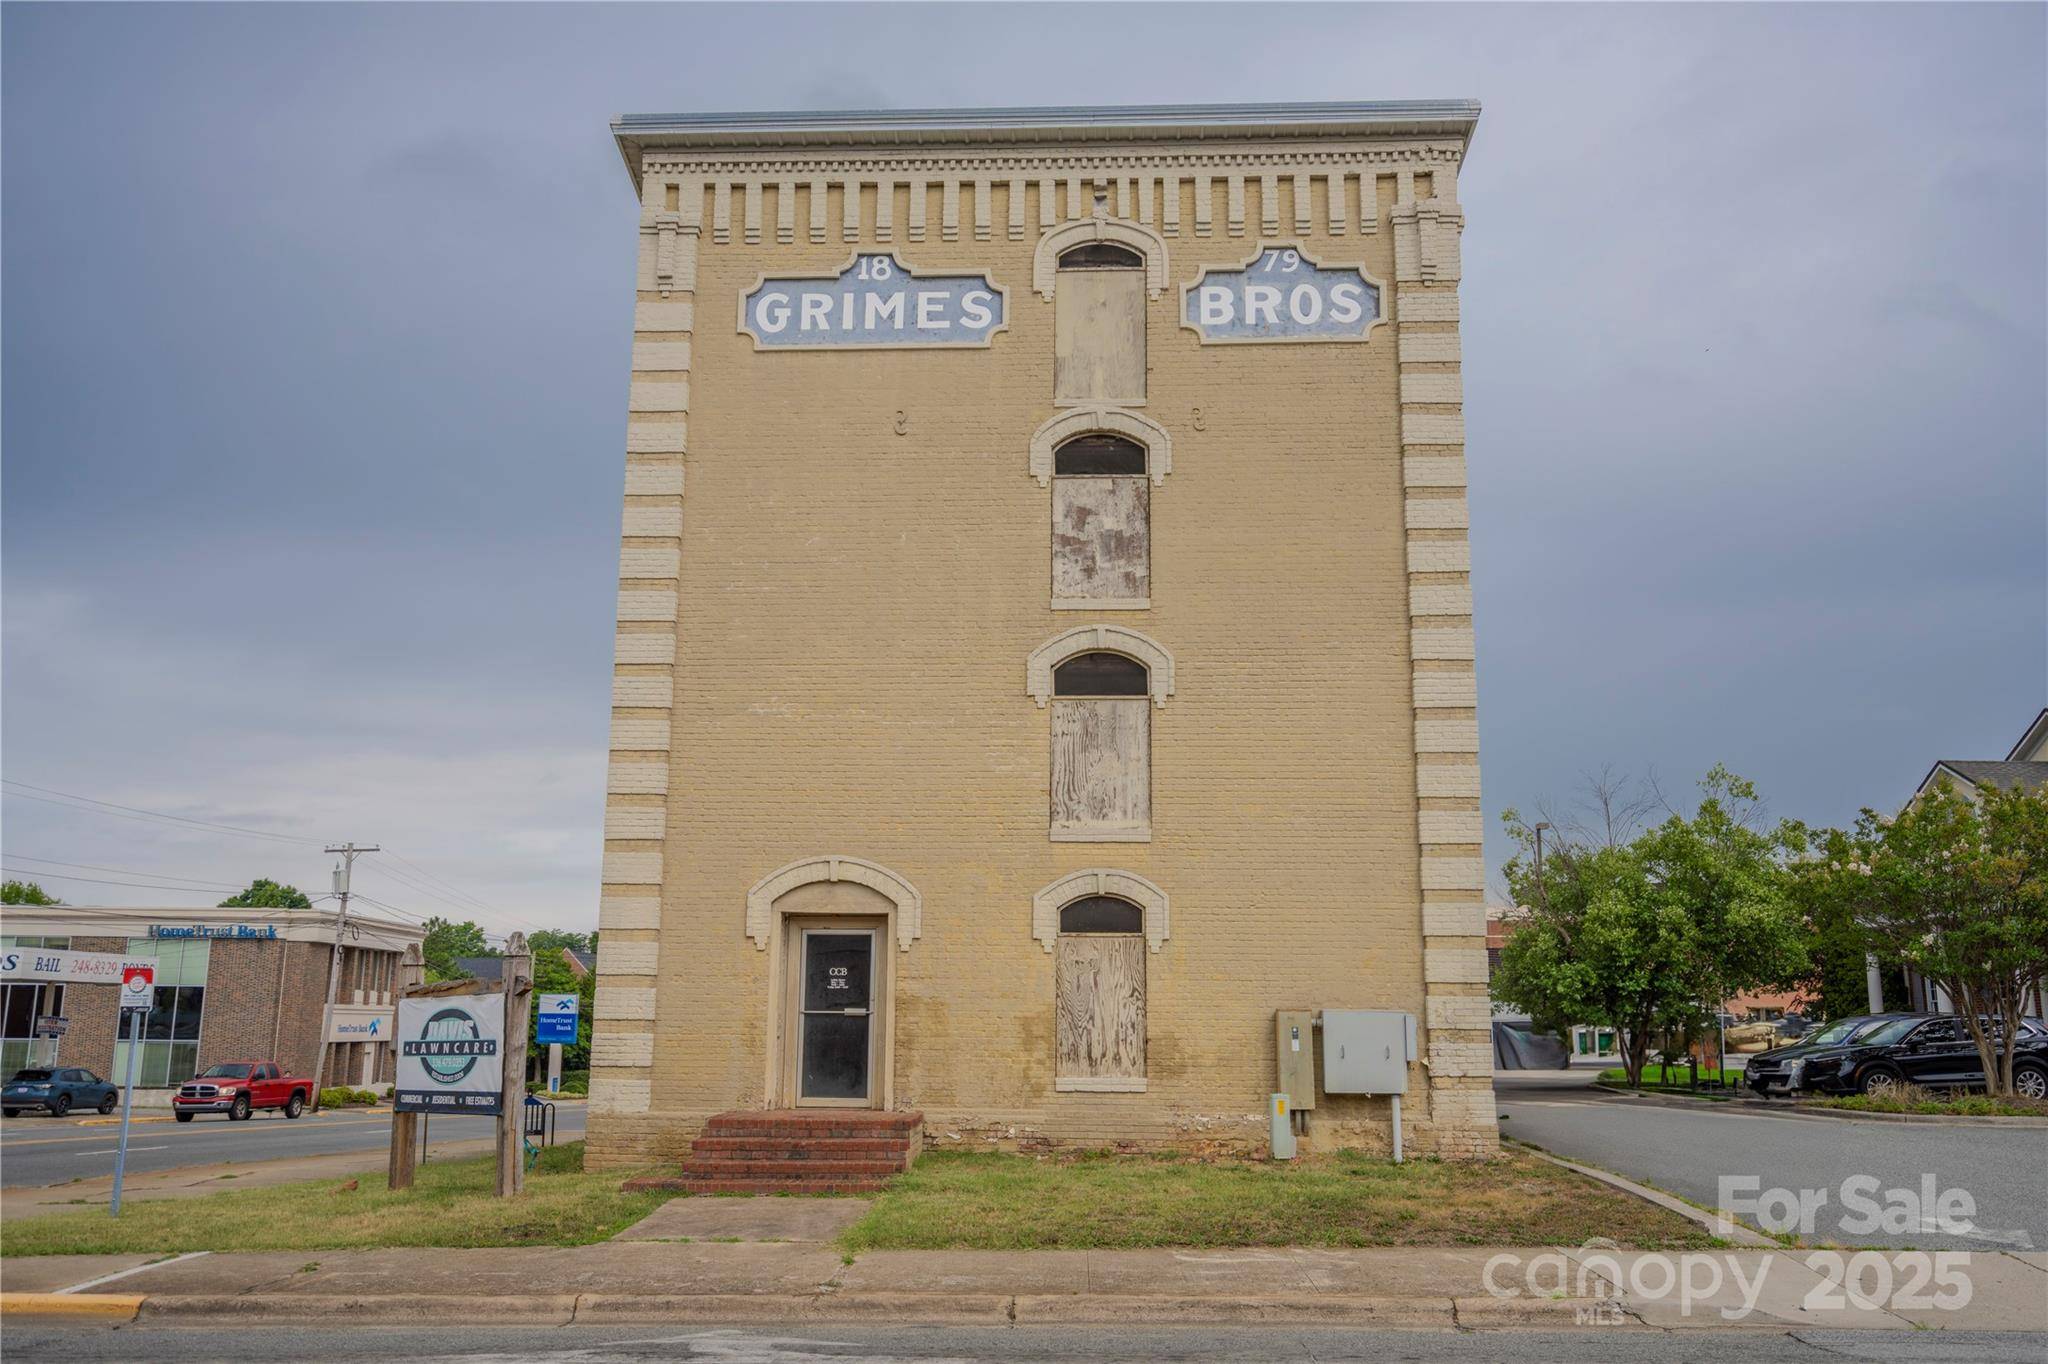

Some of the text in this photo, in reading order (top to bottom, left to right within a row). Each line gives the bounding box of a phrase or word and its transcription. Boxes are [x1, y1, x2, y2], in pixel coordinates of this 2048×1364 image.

[857, 255, 892, 282] 18
[1263, 249, 1300, 274] 79
[755, 291, 994, 334] GRIMES
[1200, 282, 1364, 326] BROS
[149, 923, 278, 939] HomeTrust Bank
[34, 957, 61, 973] BAIL
[427, 1020, 475, 1040] DAVIS
[411, 1042, 489, 1055] LAWNCARE
